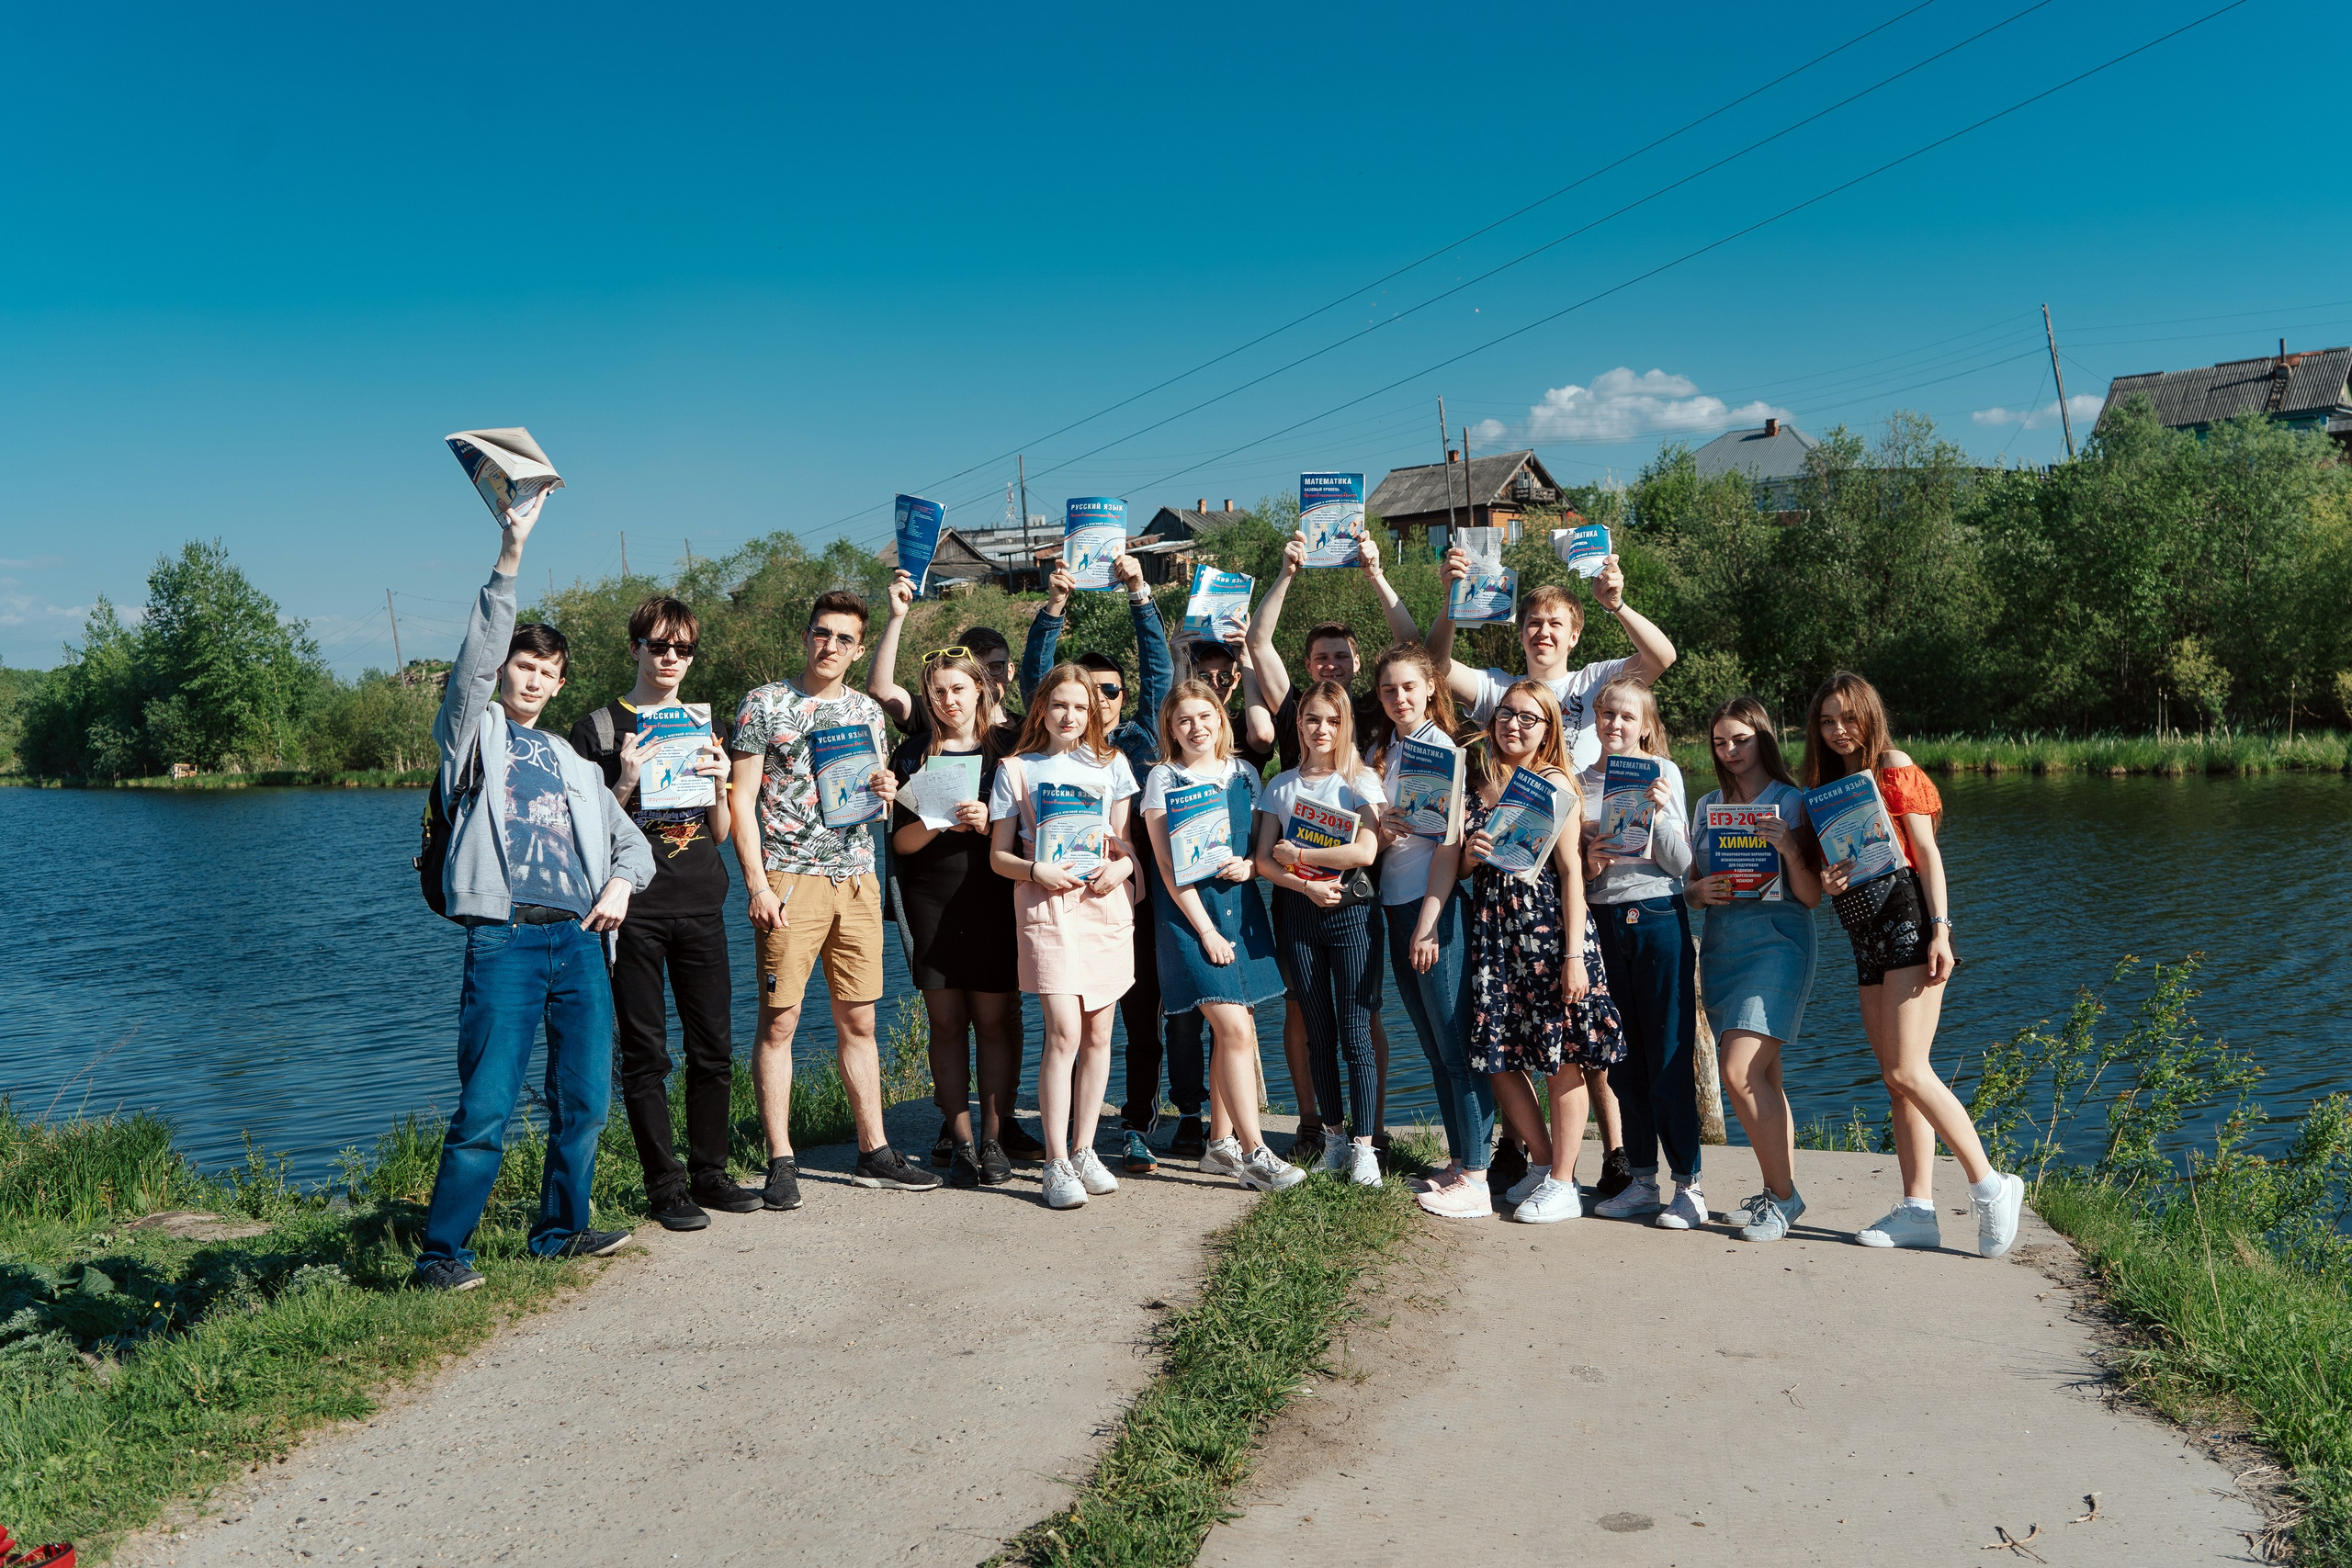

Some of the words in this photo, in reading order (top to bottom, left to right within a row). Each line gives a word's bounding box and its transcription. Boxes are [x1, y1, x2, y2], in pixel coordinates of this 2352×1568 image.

[1070, 502, 1101, 511] РУССКИЙ
[1103, 503, 1124, 512] ЯЗЫК
[818, 732, 845, 744] УССКИЙ
[848, 730, 868, 739] ЯЗЫК
[1404, 740, 1444, 760] МАТЕМАТИКА
[1416, 755, 1432, 763] УРОВЕНЬ
[1610, 760, 1651, 771] МАТЕМАТИКА
[1517, 772, 1553, 796] МАТЕМАТИ
[1042, 789, 1075, 797] РУССКИЙ
[1170, 791, 1202, 805] РУССКИЙ
[1808, 786, 1843, 805] РУССКИЙ
[1846, 778, 1867, 791] ЯЗЫК
[1294, 802, 1352, 832] ЕГЭ-2019
[1710, 812, 1774, 826] ЕГЭ-20
[1296, 827, 1341, 848] ХИМИЯ
[1718, 836, 1767, 849] ХИМИЯ
